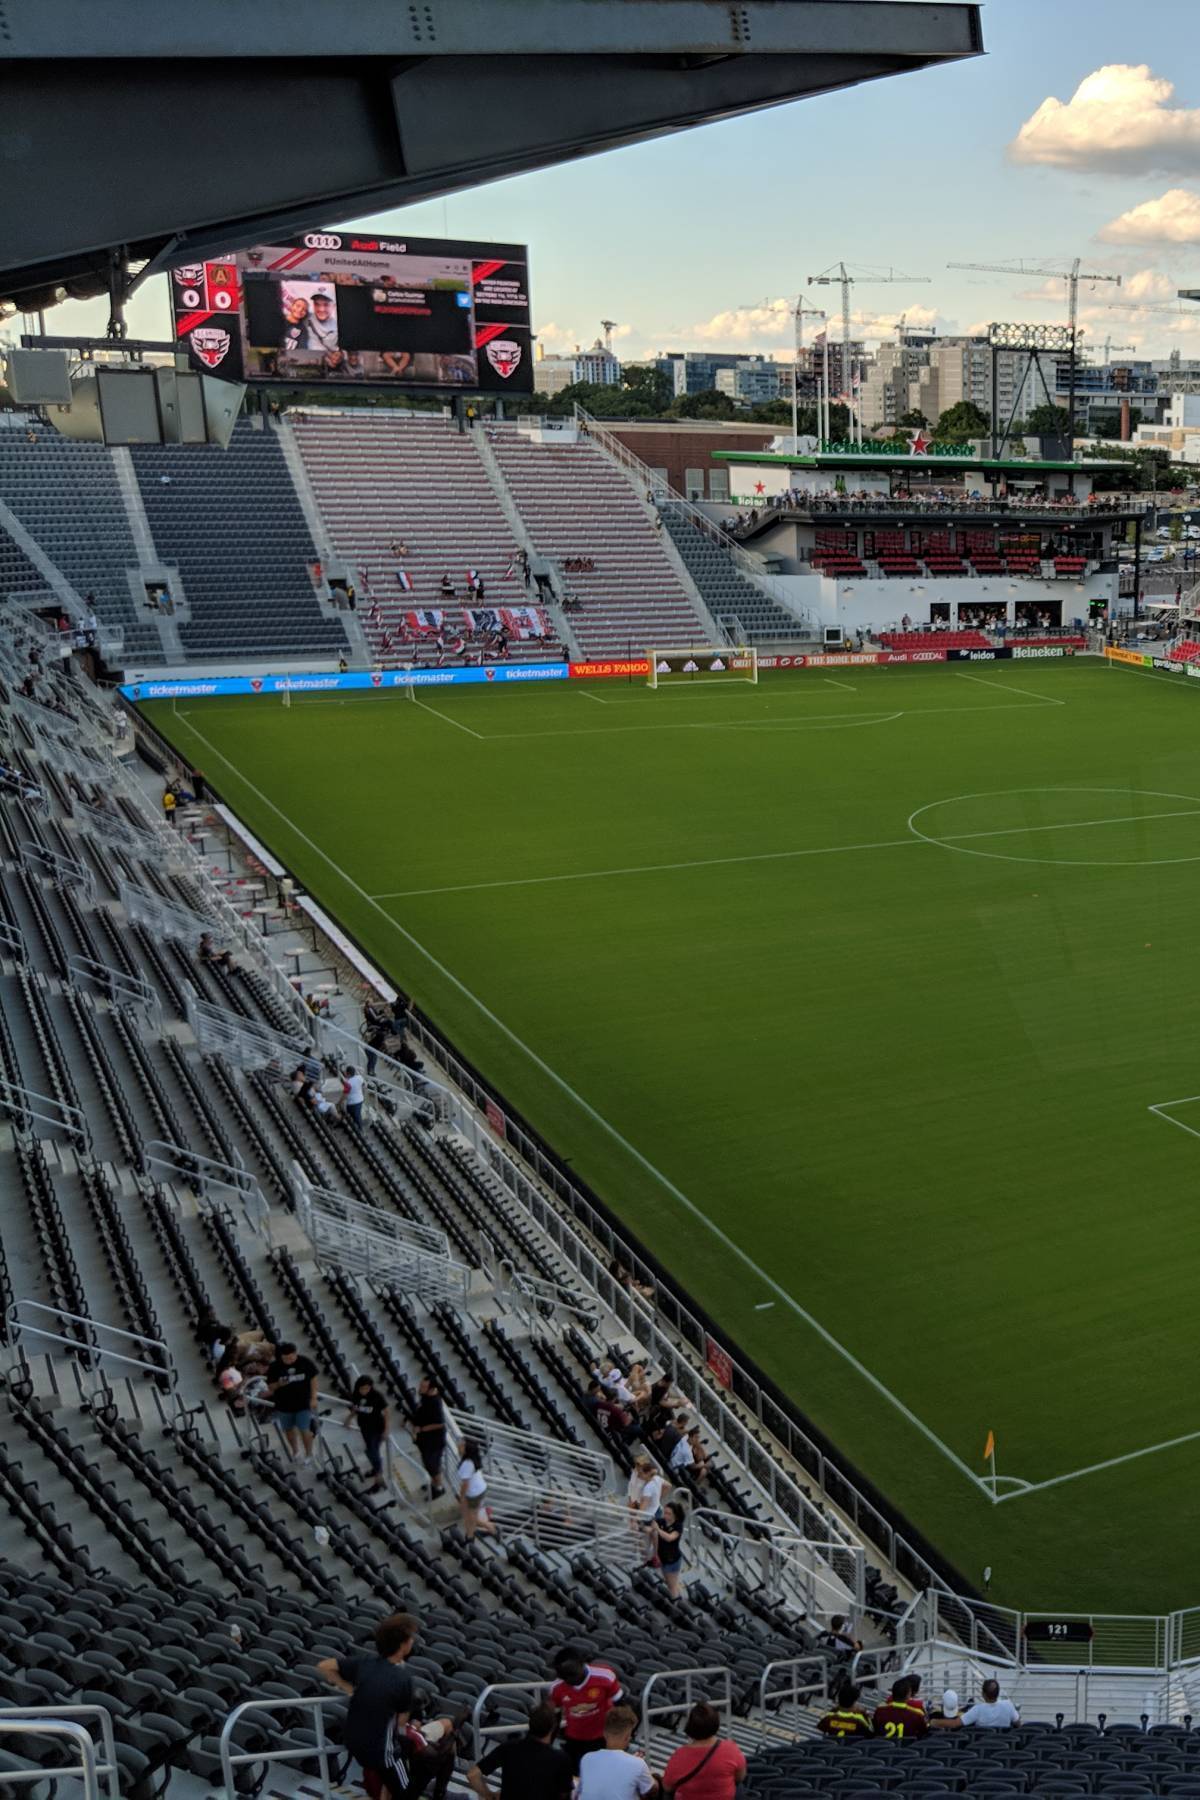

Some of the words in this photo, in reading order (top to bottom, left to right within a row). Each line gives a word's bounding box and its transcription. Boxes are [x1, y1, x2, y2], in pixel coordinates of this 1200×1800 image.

[351, 240, 378, 251] Audi
[380, 242, 407, 253] Field
[183, 289, 200, 308] 0
[215, 291, 232, 309] 0
[809, 655, 824, 665] THE
[826, 654, 850, 664] HOME
[852, 653, 878, 663] DEPOT
[888, 653, 907, 661] Audi
[970, 650, 995, 660] leidos
[1012, 646, 1064, 659] Heineken
[506, 667, 563, 680] ticketmaster
[575, 665, 611, 675] WELLS
[614, 663, 648, 673] FARGO
[275, 677, 340, 690] ticketmaster
[394, 673, 455, 685] ticketmaster
[149, 682, 217, 696] ticketmaster
[1048, 1624, 1068, 1634] 121
[885, 1721, 905, 1738] 21
